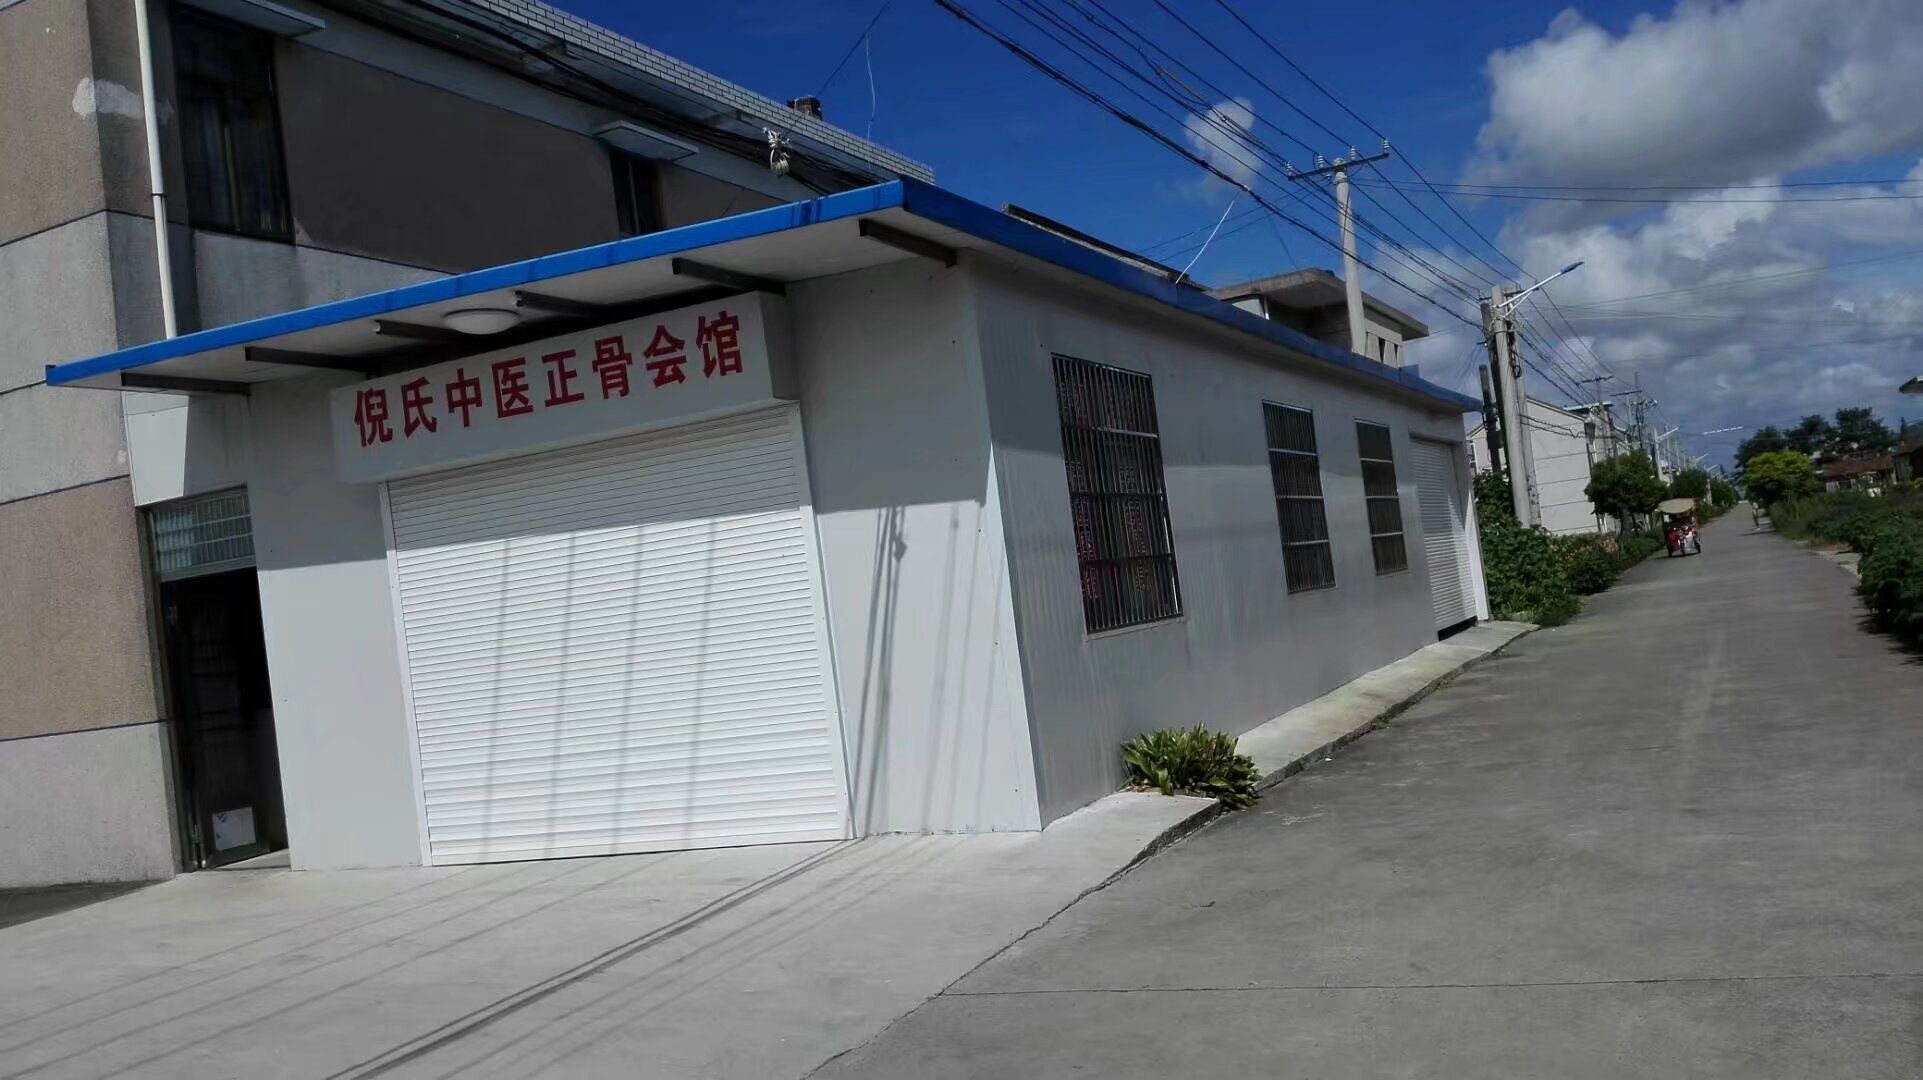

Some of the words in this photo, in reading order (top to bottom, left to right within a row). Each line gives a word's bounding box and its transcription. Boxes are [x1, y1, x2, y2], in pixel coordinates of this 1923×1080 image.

[354, 310, 743, 447] 倪氏中医正骨会馆
